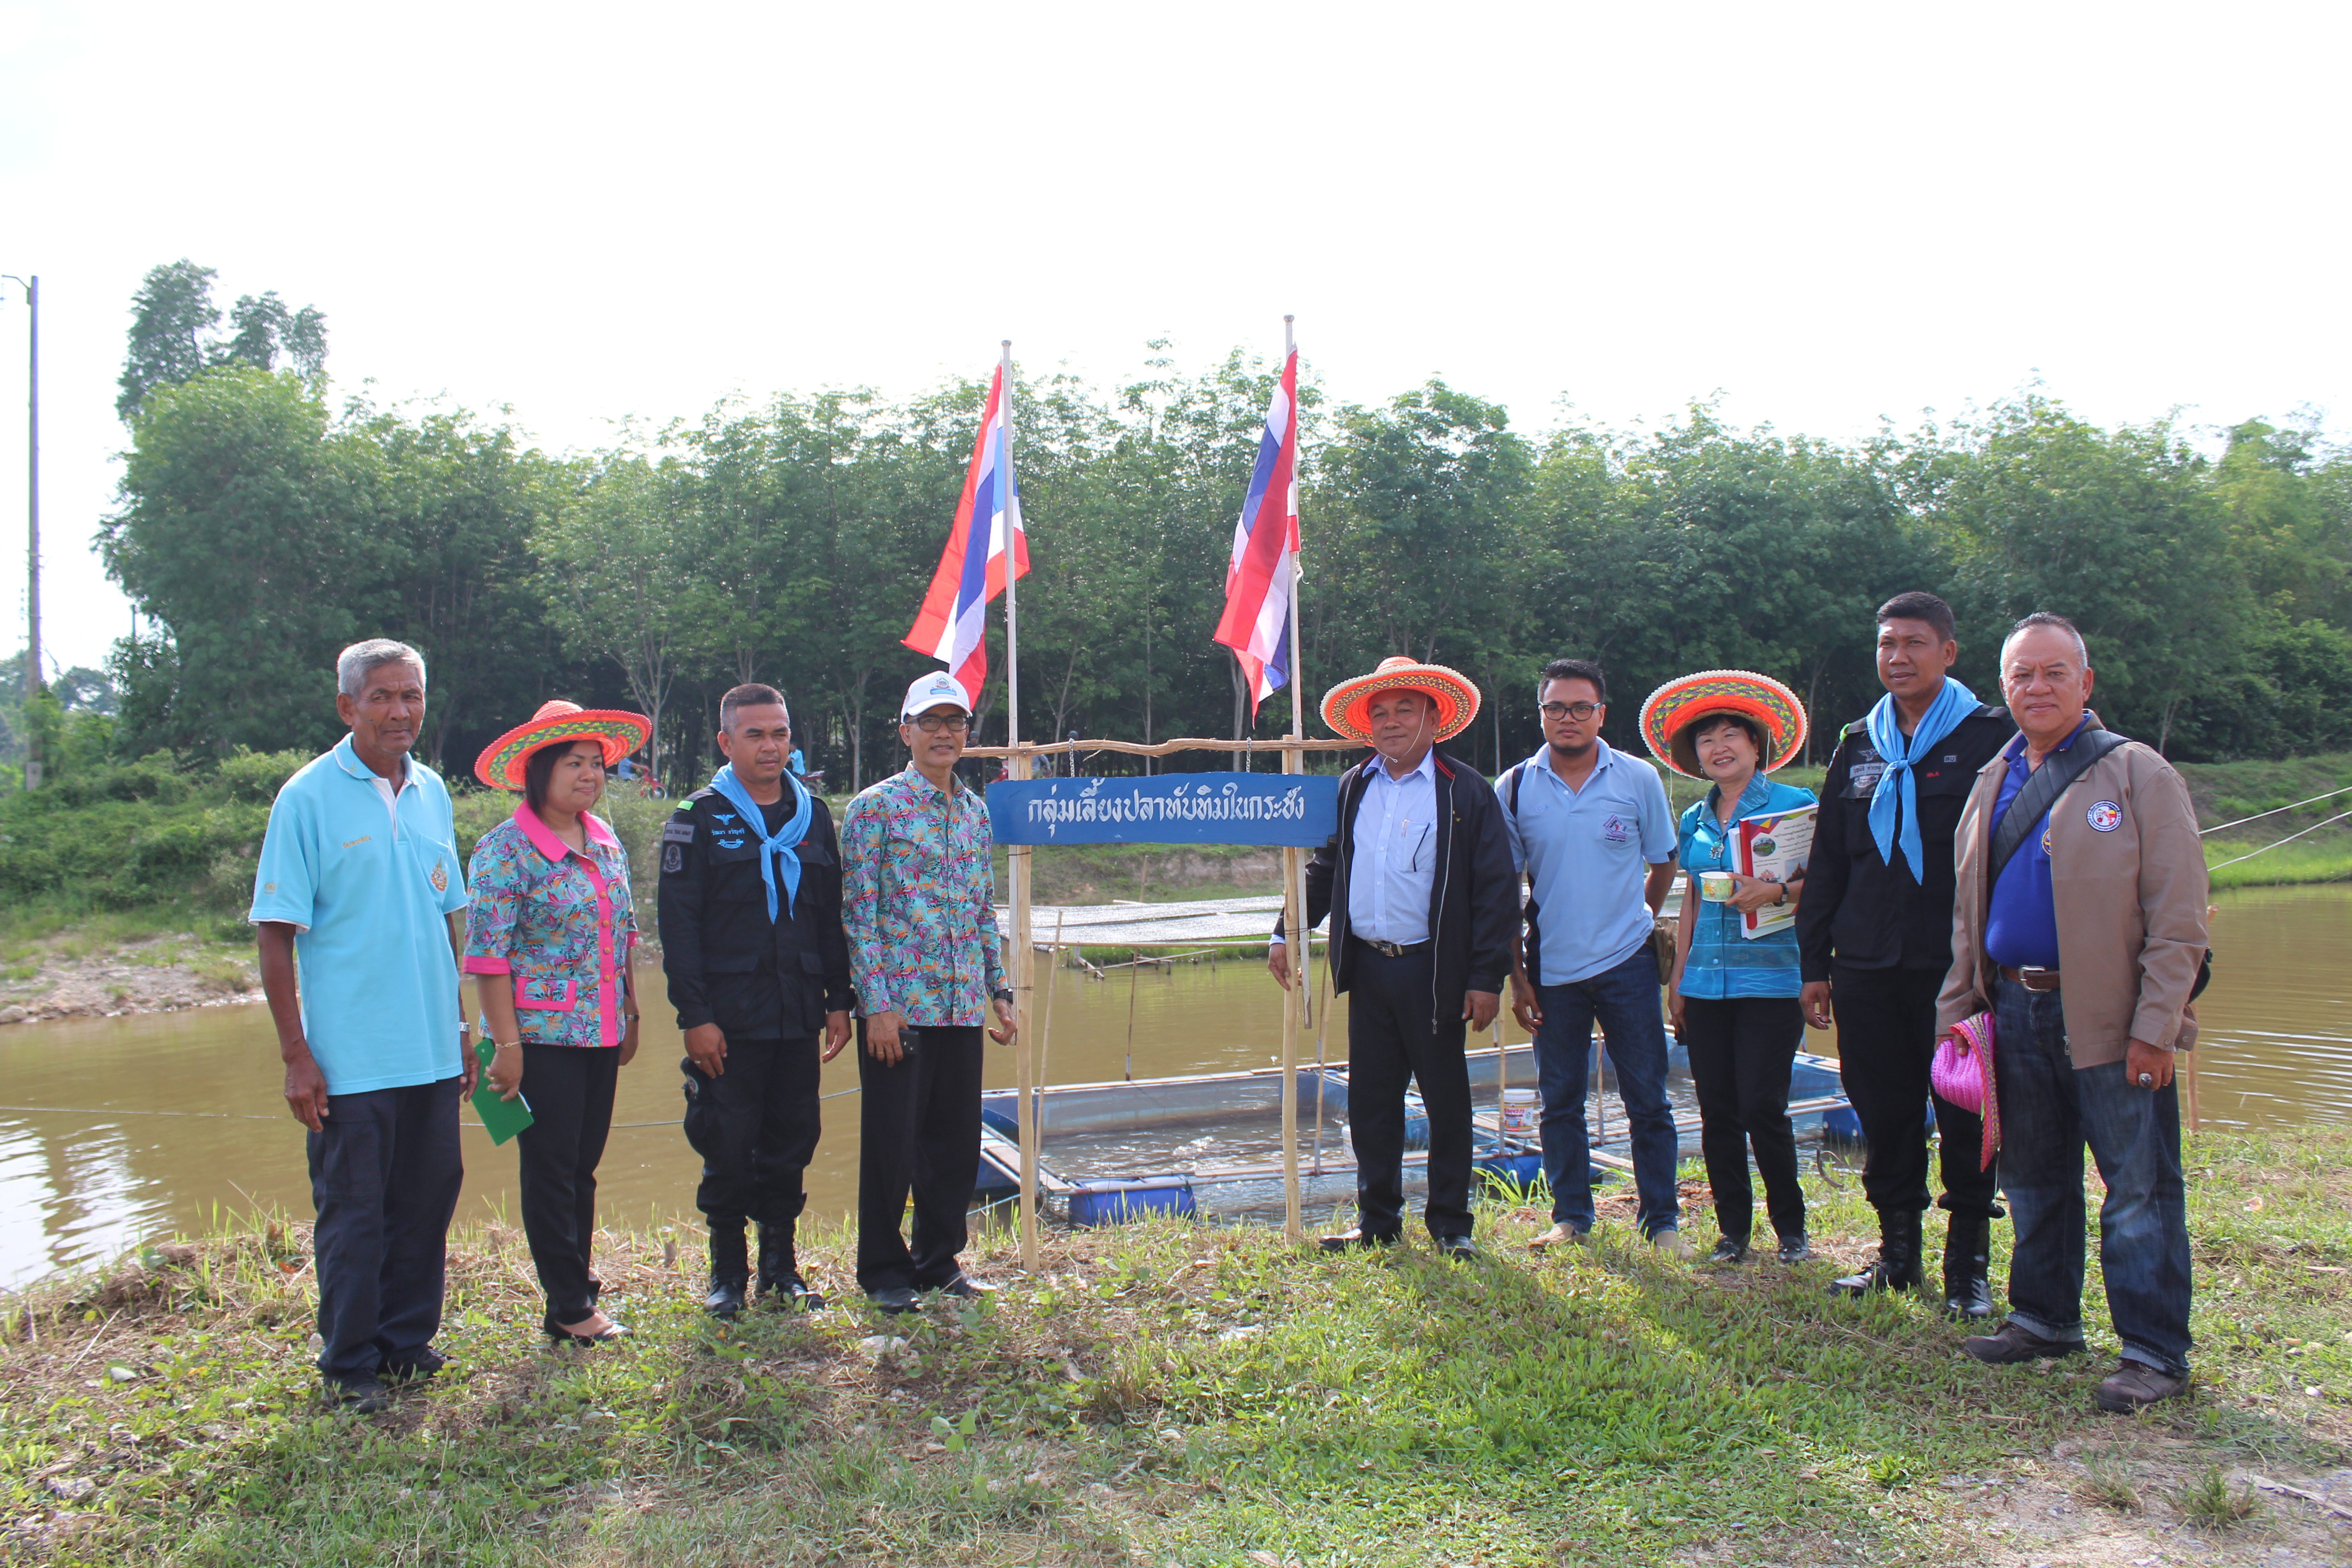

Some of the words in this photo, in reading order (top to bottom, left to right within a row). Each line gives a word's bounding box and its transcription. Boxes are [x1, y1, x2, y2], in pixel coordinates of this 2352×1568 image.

[1028, 777, 1304, 838] กลุ่มเลี้ยงปลาทับทิมในกระชัง
